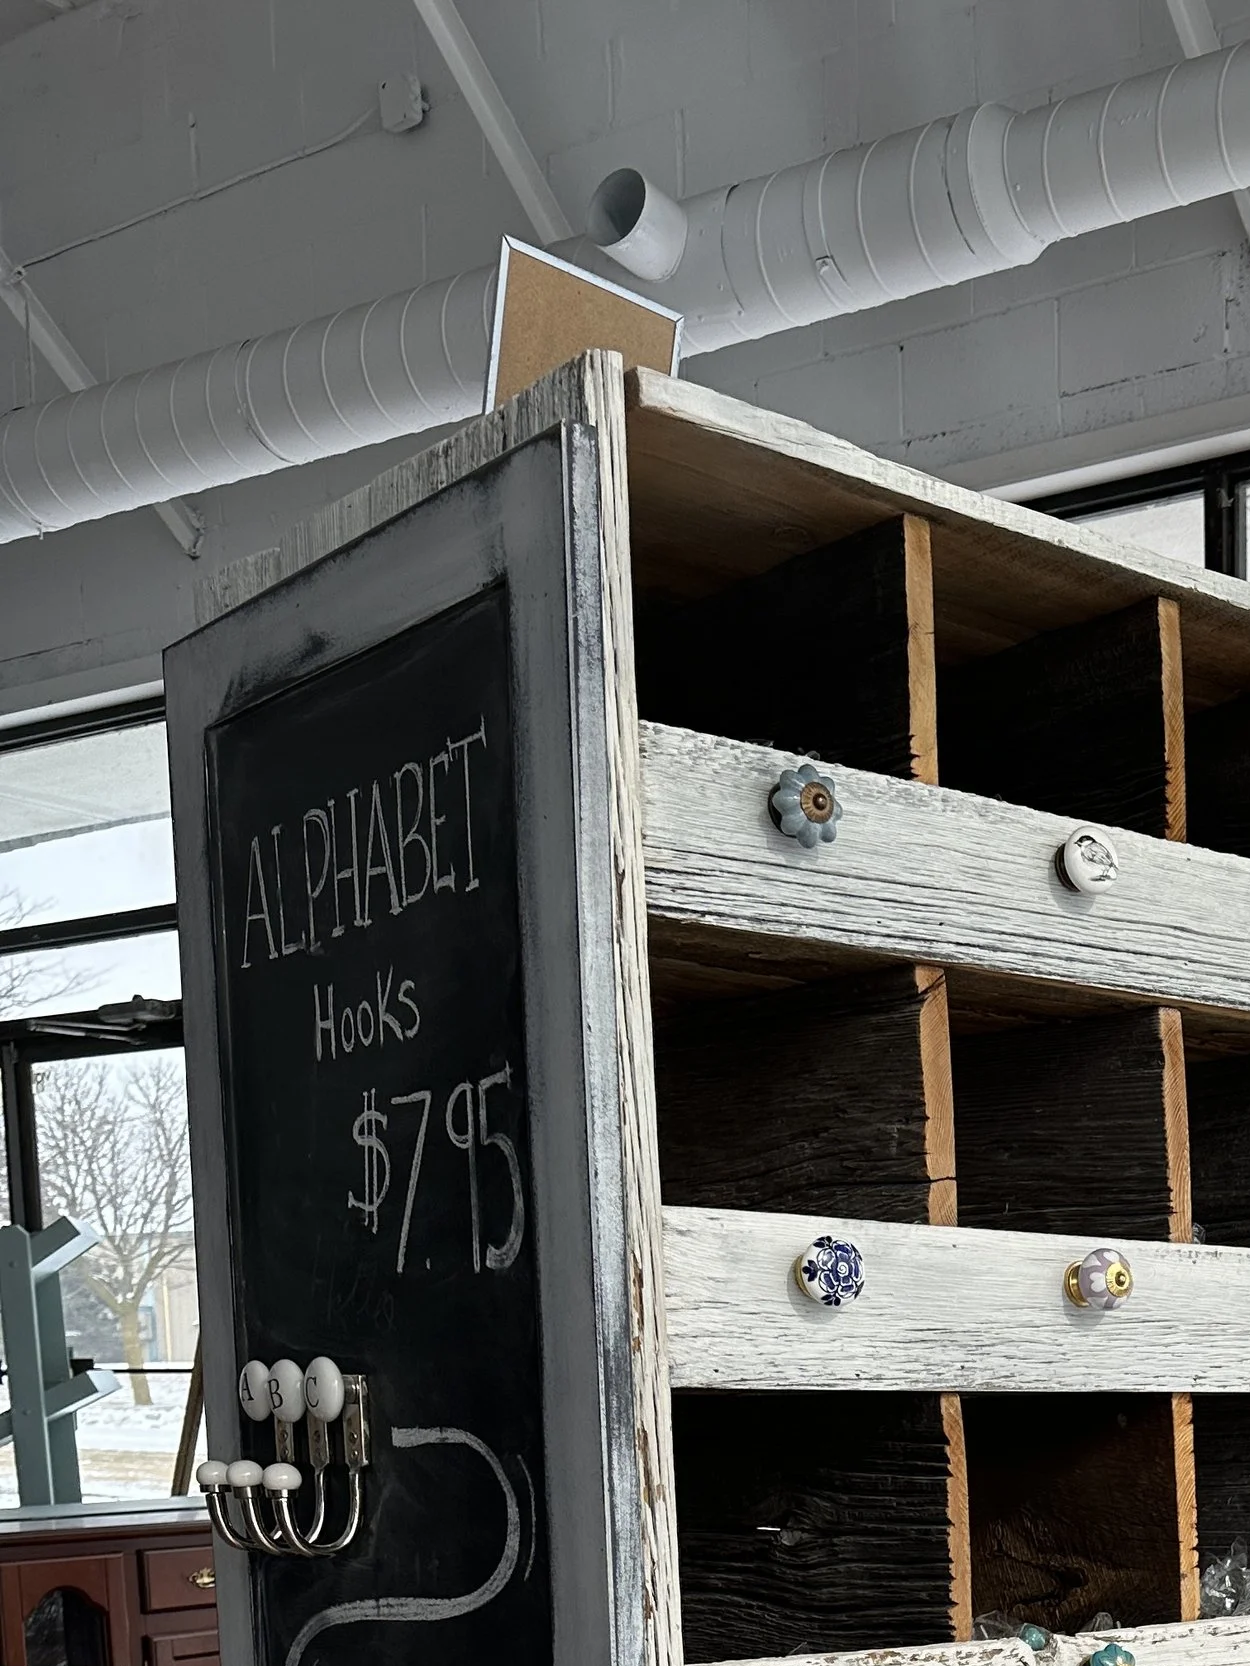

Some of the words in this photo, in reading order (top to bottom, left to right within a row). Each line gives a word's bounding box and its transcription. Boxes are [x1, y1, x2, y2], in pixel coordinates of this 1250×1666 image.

[240, 713, 487, 968] ALPHABET
[346, 1061, 525, 1274] $7.95
[241, 1372, 255, 1402] A
[268, 1378, 284, 1410] B
[305, 1376, 320, 1408] C
